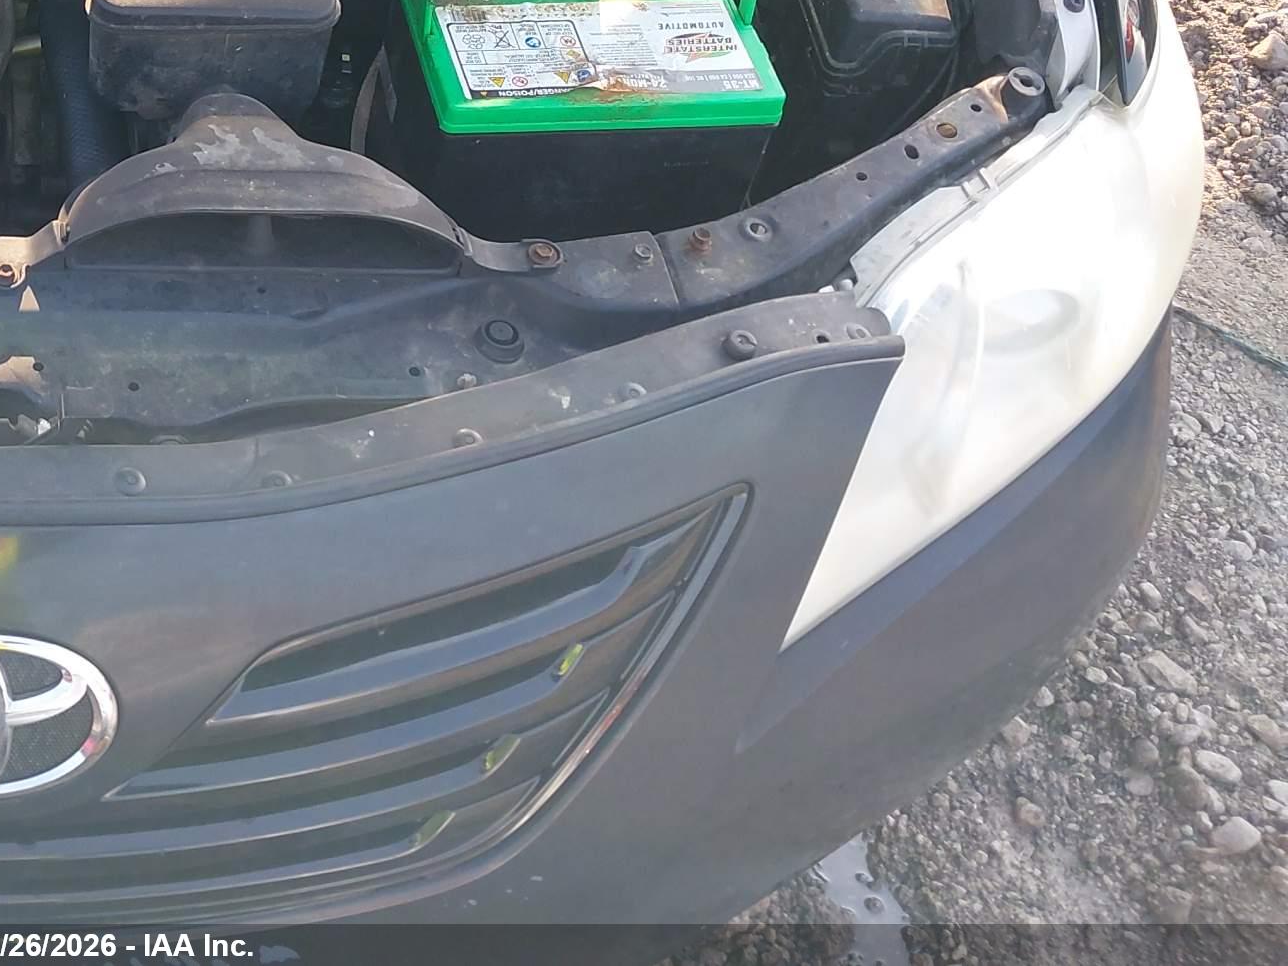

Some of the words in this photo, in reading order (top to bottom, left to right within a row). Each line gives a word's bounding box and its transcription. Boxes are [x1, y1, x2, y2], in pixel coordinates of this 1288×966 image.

[657, 21, 725, 31] AUTOMOTIVE
[667, 37, 732, 46] BATTERIES
[663, 44, 738, 54] INTERSTATE
[498, 88, 570, 97] ANGER/POISON
